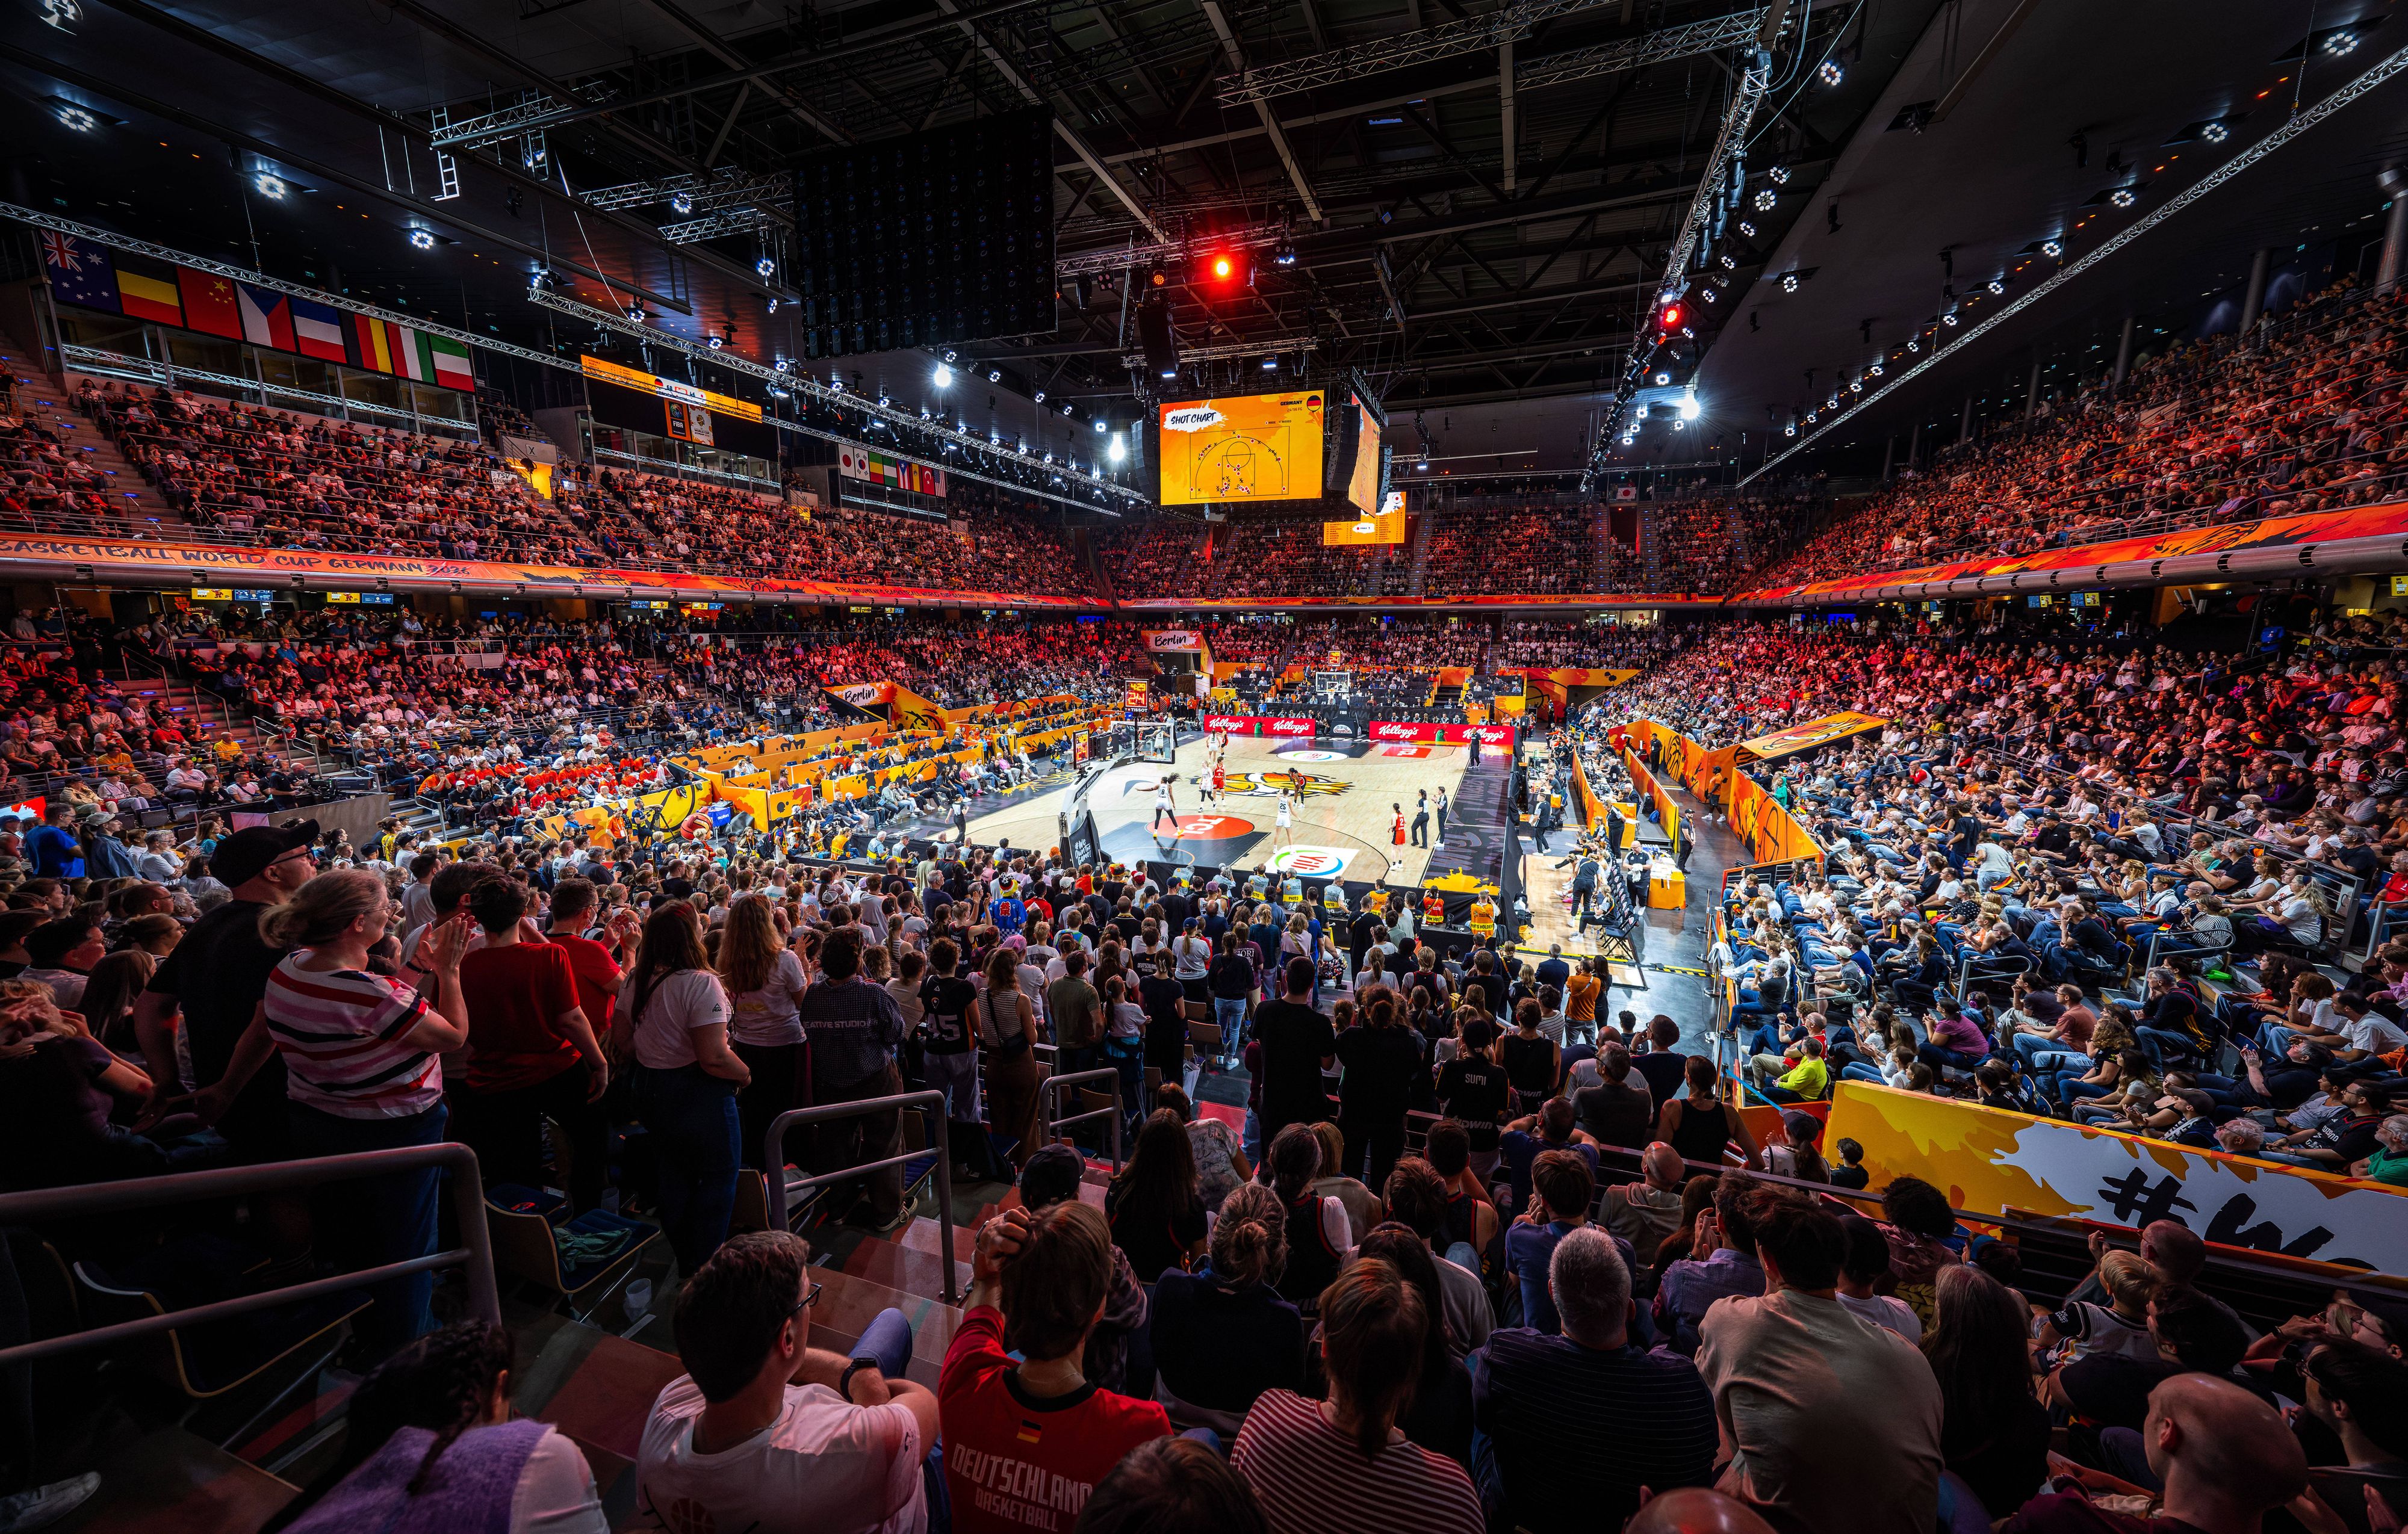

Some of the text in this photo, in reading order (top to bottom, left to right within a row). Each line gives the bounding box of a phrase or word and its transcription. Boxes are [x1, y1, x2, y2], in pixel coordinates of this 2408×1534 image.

[1171, 412, 1217, 424] SHOT CHART
[528, 446, 535, 455] X
[181, 549, 265, 564] WORLD
[276, 555, 322, 568] CUP
[329, 558, 423, 572] GERMANY
[426, 564, 470, 575] 2026
[1155, 635, 1186, 647] Berlin
[845, 688, 874, 703] Berlin
[1128, 692, 1144, 705] 24
[1209, 717, 1244, 731] Kellogg's
[1273, 718, 1310, 733] Kellogg's
[1379, 723, 1419, 738] Kellogg's
[1077, 745, 1087, 760] 24
[1173, 818, 1226, 836] TCL
[1075, 839, 1086, 849] #We
[1078, 850, 1091, 865] Game!
[1291, 856, 1327, 870] Yili
[1000, 902, 1011, 917] 祭
[1465, 1074, 1486, 1086] SUMI
[951, 1443, 1093, 1515] DEUTSCHLAND
[975, 1486, 1059, 1532] BASKETBALL
